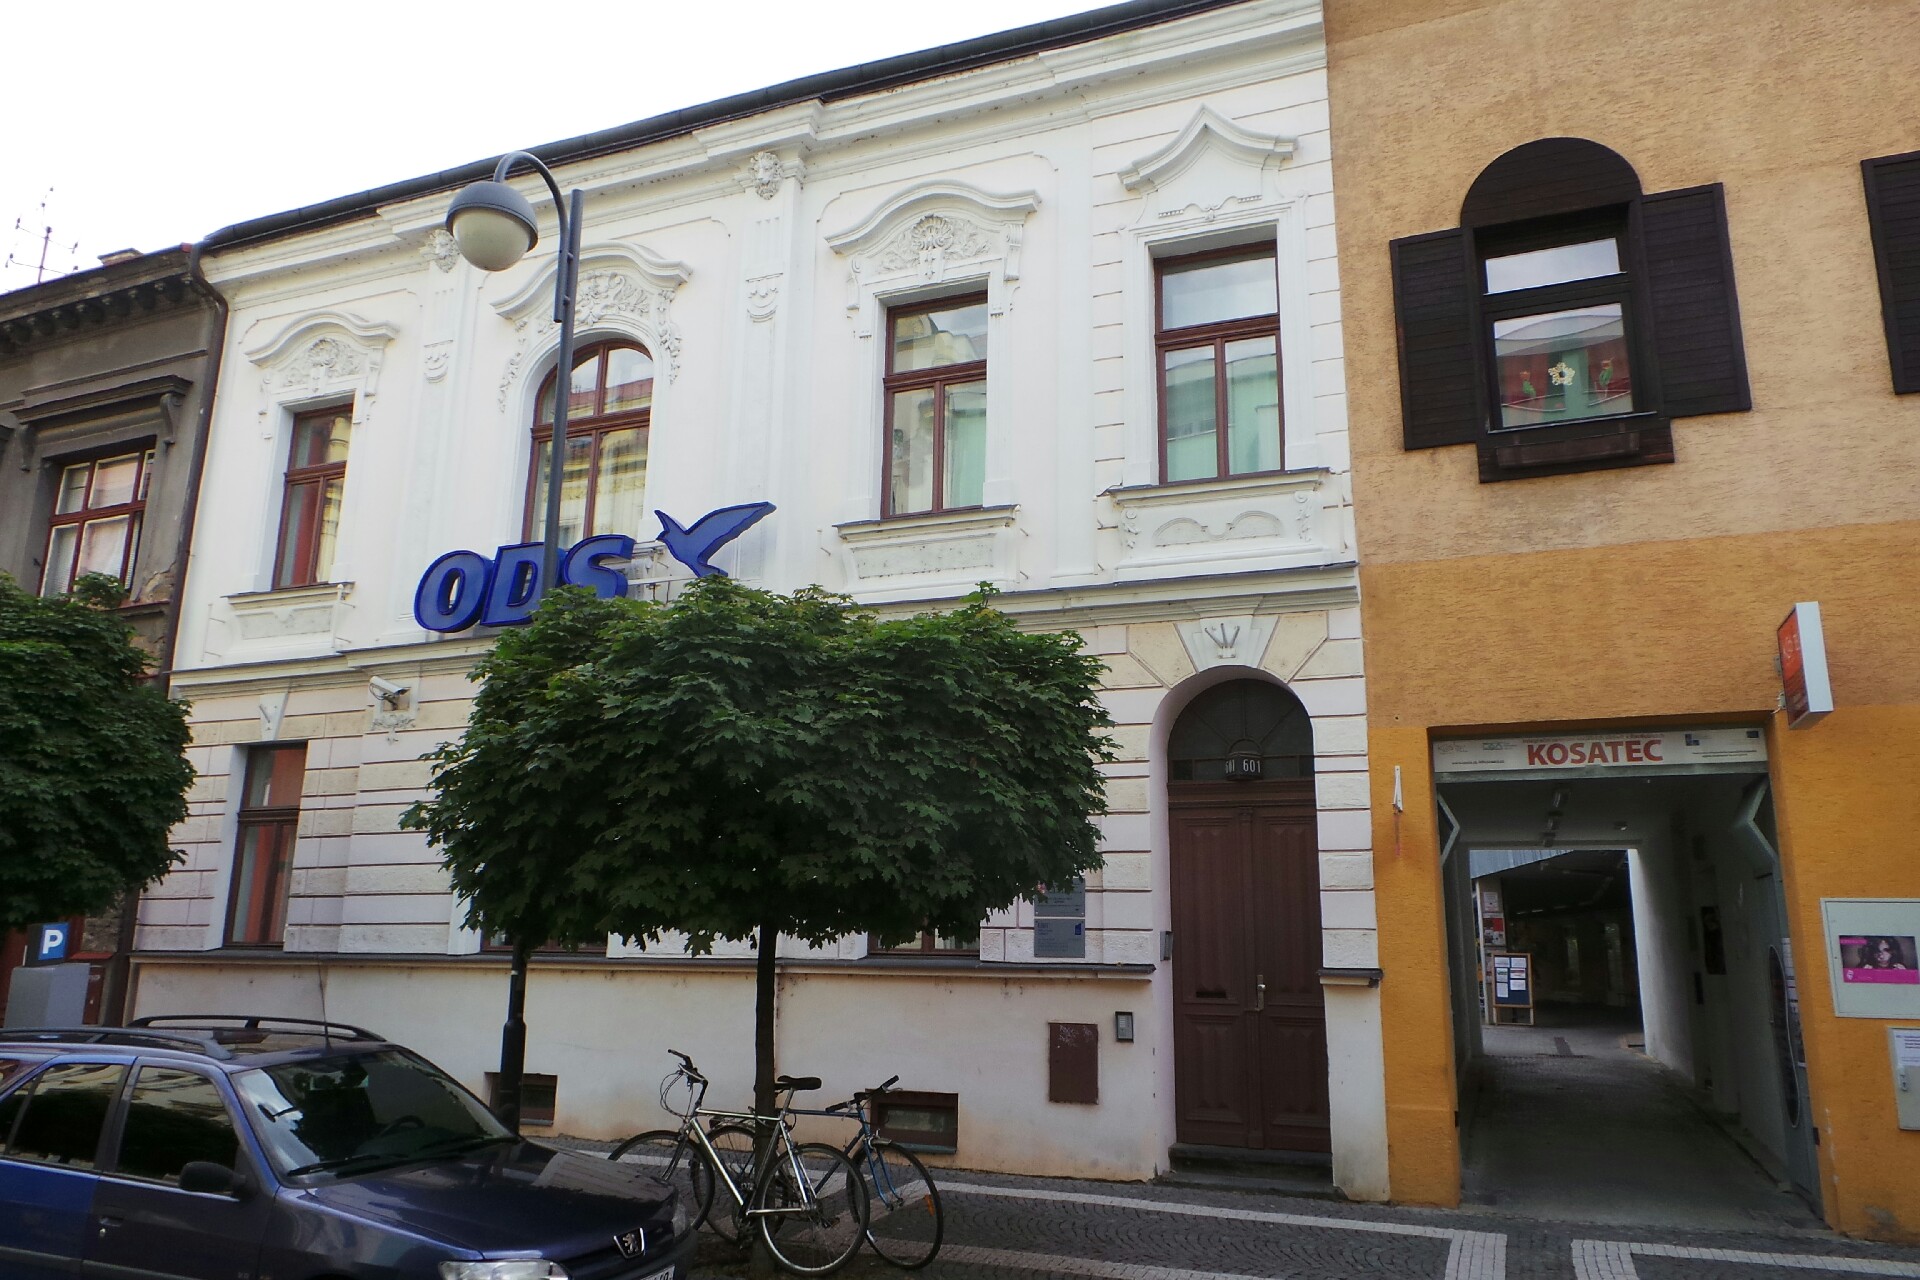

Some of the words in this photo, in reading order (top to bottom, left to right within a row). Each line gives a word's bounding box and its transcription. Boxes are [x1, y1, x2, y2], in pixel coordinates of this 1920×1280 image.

[414, 534, 635, 633] ODS
[1243, 758, 1261, 773] 601
[1528, 740, 1663, 766] KOSATEC
[42, 929, 64, 954] P
